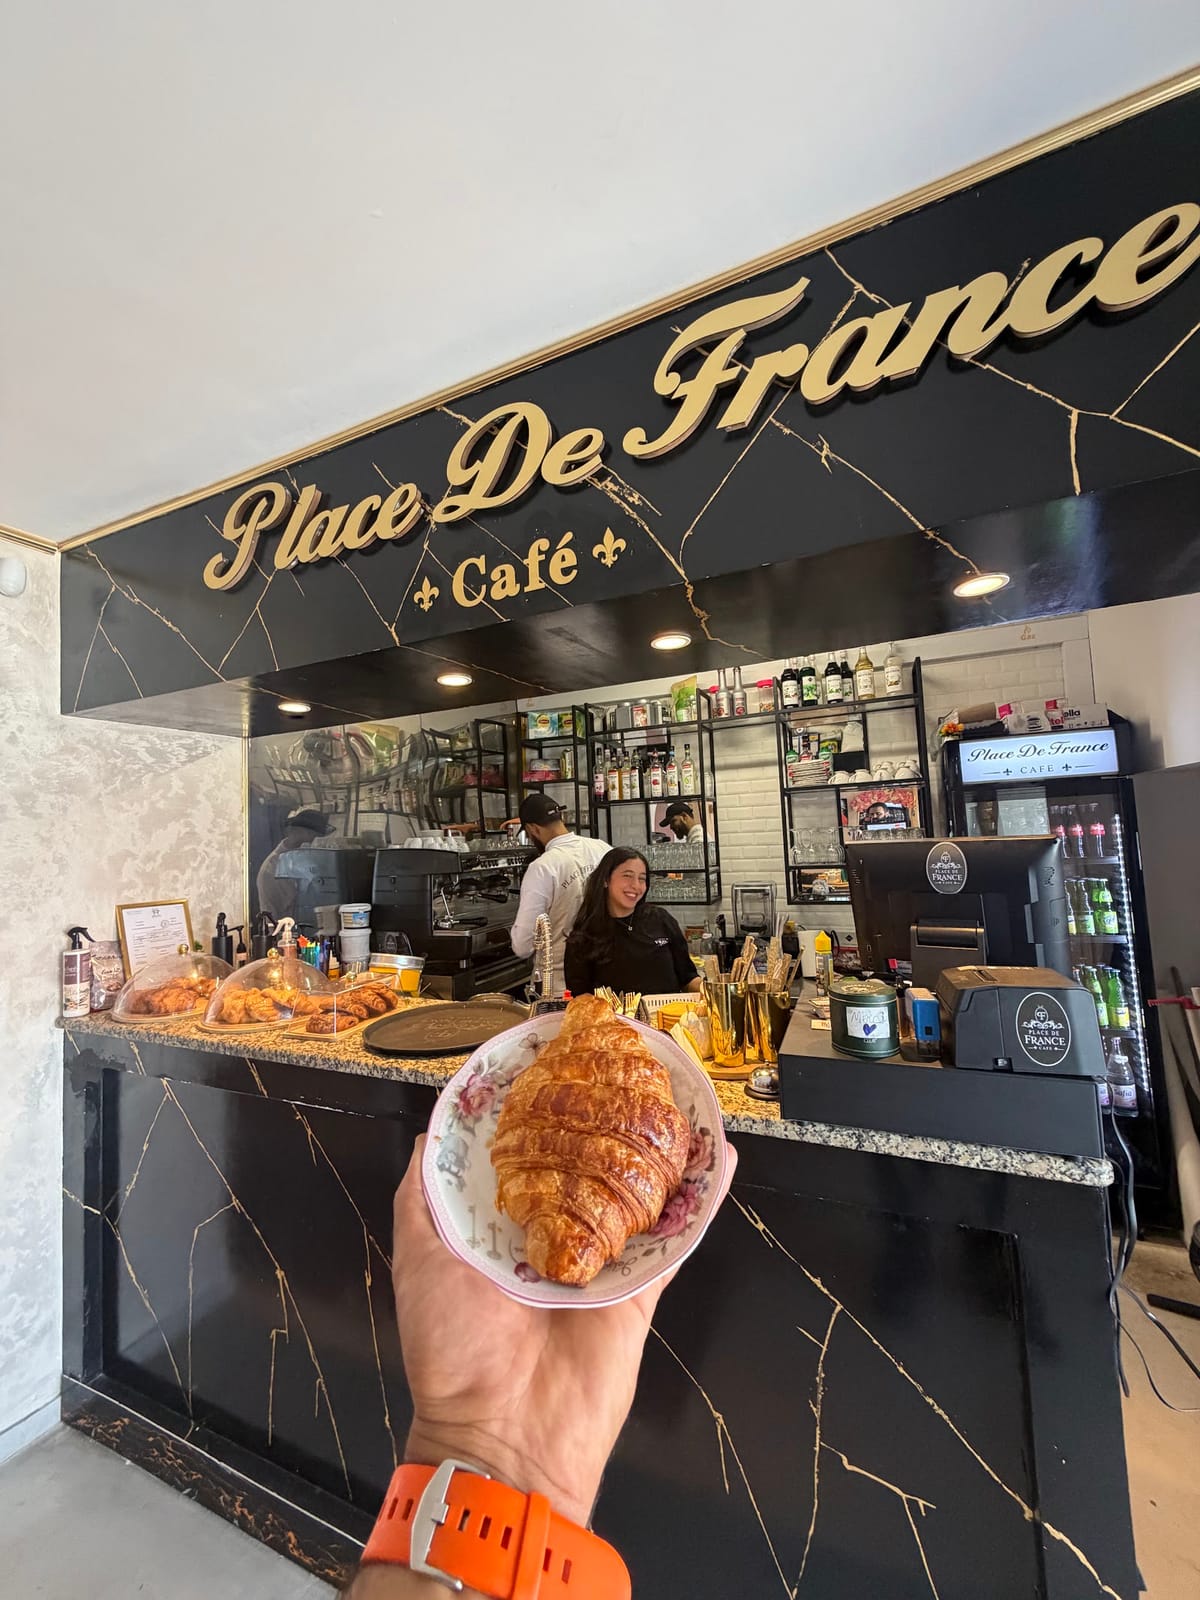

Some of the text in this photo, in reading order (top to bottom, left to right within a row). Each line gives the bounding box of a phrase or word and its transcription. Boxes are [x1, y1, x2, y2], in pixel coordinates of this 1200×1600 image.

[203, 202, 1200, 591] Place De France
[452, 531, 577, 608] Café
[967, 740, 1109, 762] Place De France
[932, 873, 963, 882] FRANCE
[1024, 1034, 1066, 1047] FRANCE
